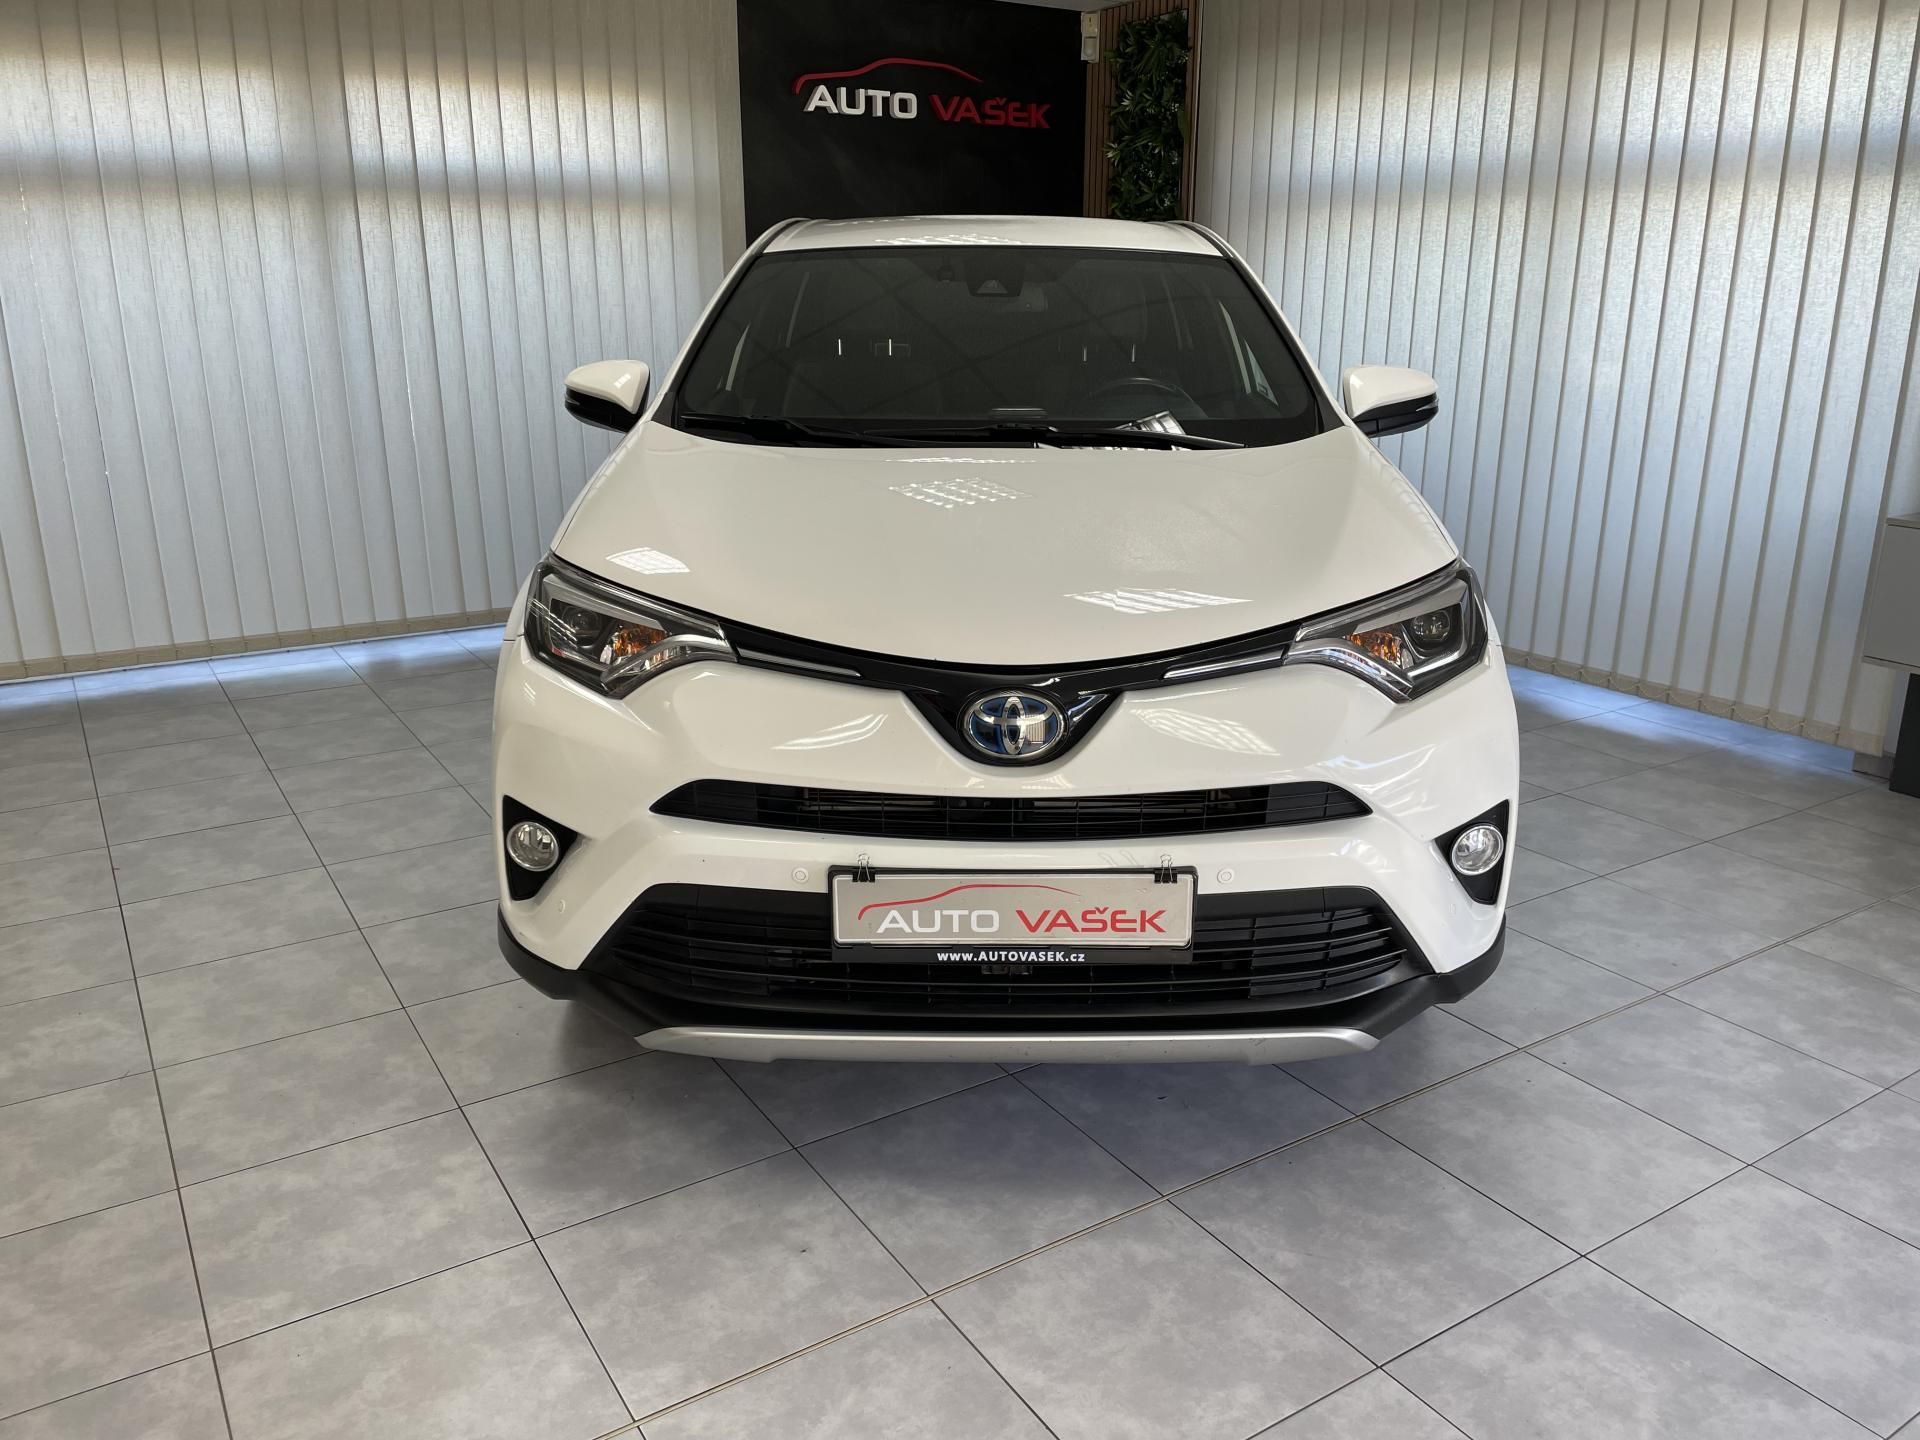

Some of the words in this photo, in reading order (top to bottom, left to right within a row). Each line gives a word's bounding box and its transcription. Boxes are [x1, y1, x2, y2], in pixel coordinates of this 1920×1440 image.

[804, 84, 918, 119] AUTO
[929, 95, 1051, 129] VAŠEK
[876, 909, 999, 933] AUTO
[1016, 906, 1167, 933] VAŠEK
[936, 950, 1086, 963] www.AUTOVASEK.cz
